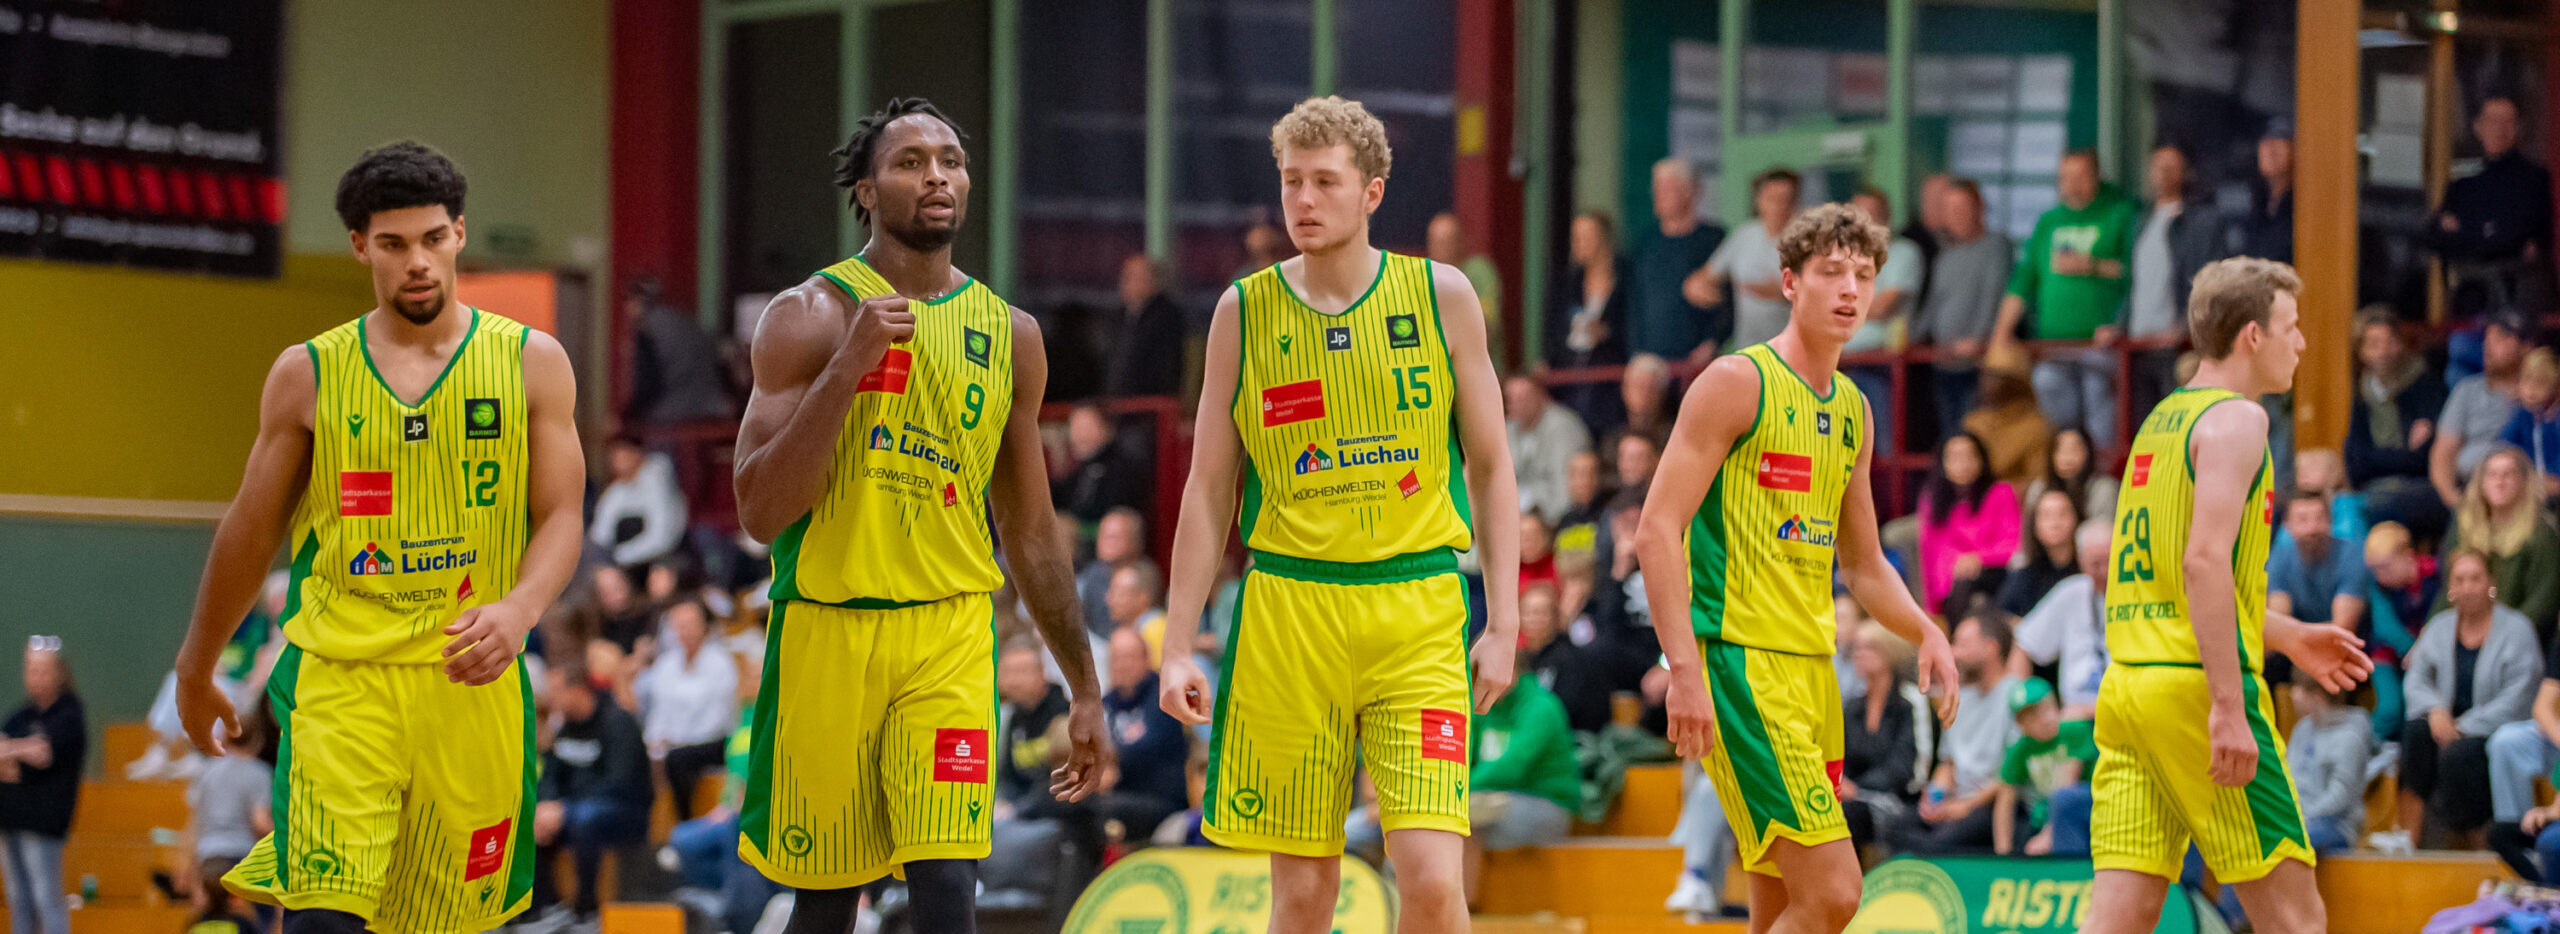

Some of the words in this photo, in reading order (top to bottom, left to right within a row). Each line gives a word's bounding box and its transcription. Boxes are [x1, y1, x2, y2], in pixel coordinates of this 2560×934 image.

[1391, 365, 1432, 411] 15
[960, 382, 985, 431] 9
[1336, 433, 1398, 447] Bauzentrum
[1338, 445, 1419, 468] Lüchau
[461, 460, 501, 508] 12
[1292, 480, 1387, 502] KÜCHENWELTEN
[2118, 507, 2154, 583] 29
[401, 548, 477, 573] Lüchau
[937, 756, 986, 765] Stadtsparkasse
[951, 764, 973, 772] Wedel
